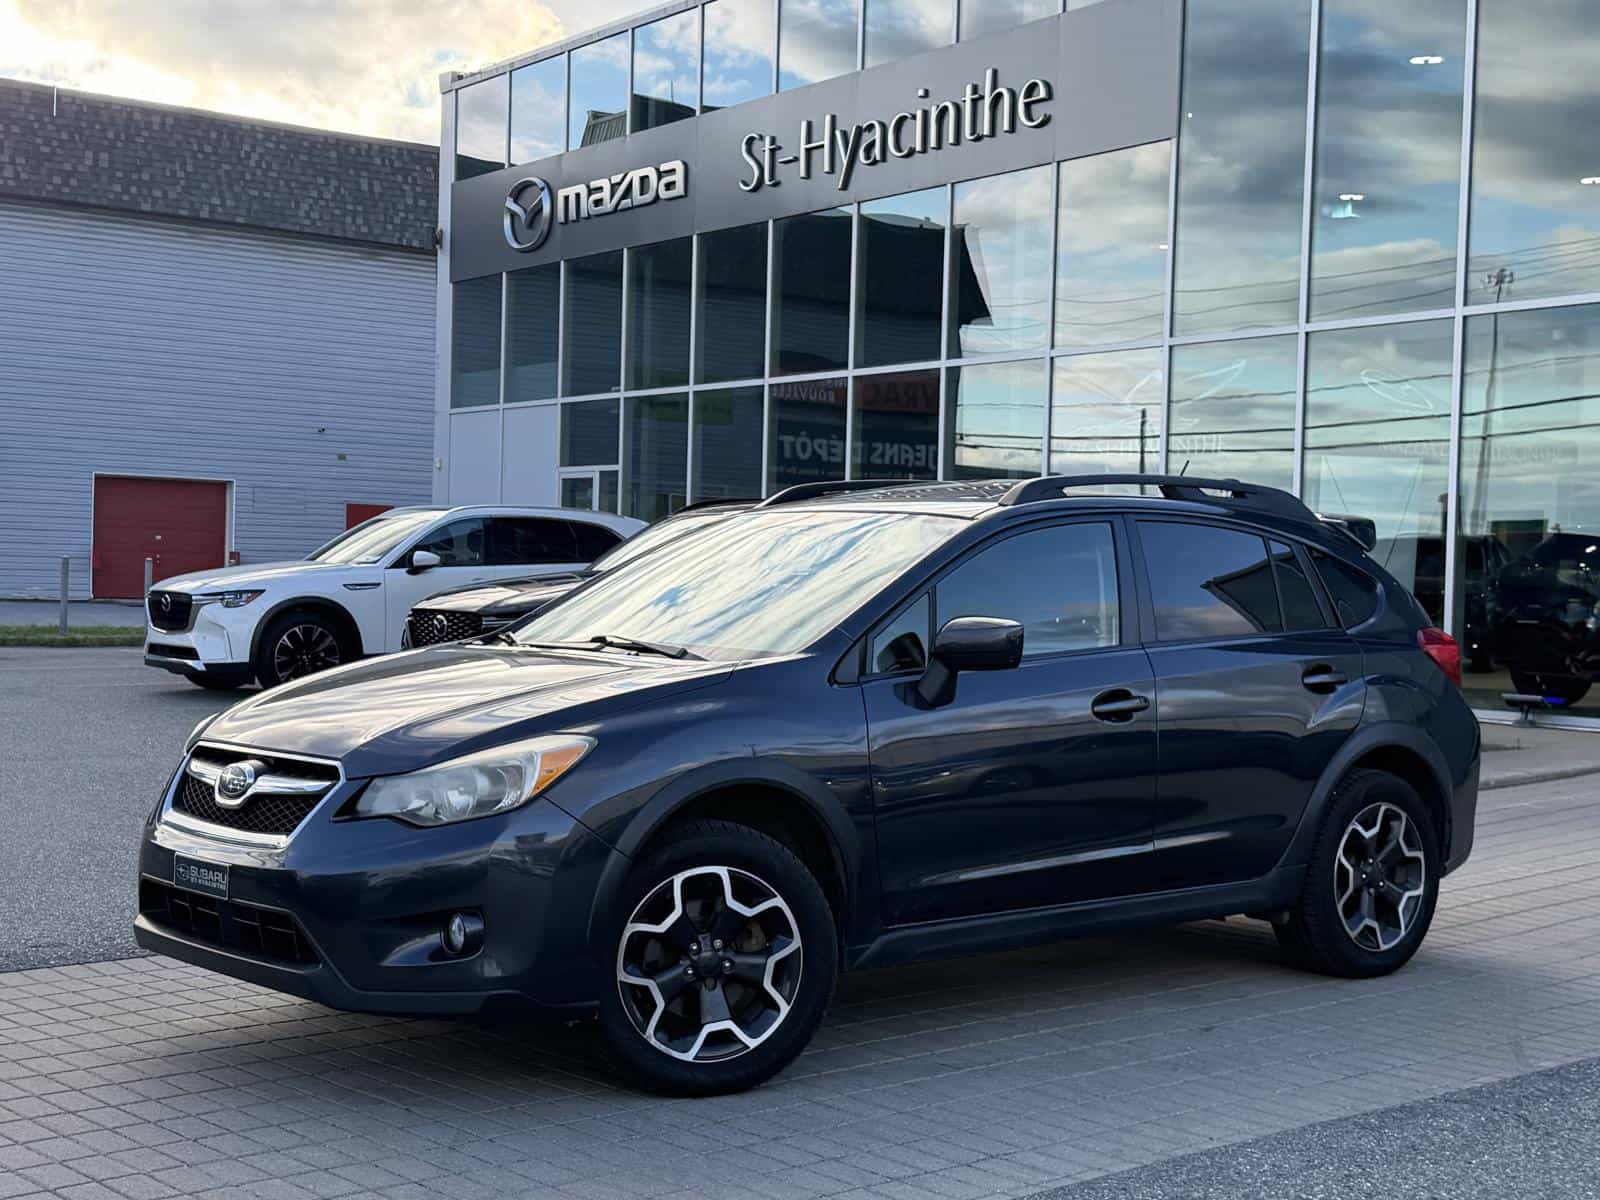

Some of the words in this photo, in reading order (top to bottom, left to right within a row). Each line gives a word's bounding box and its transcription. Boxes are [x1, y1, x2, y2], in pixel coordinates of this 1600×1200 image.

[739, 68, 1051, 191] St-Hyacinthe
[557, 159, 688, 223] mazda
[190, 866, 227, 884] SUBARU
